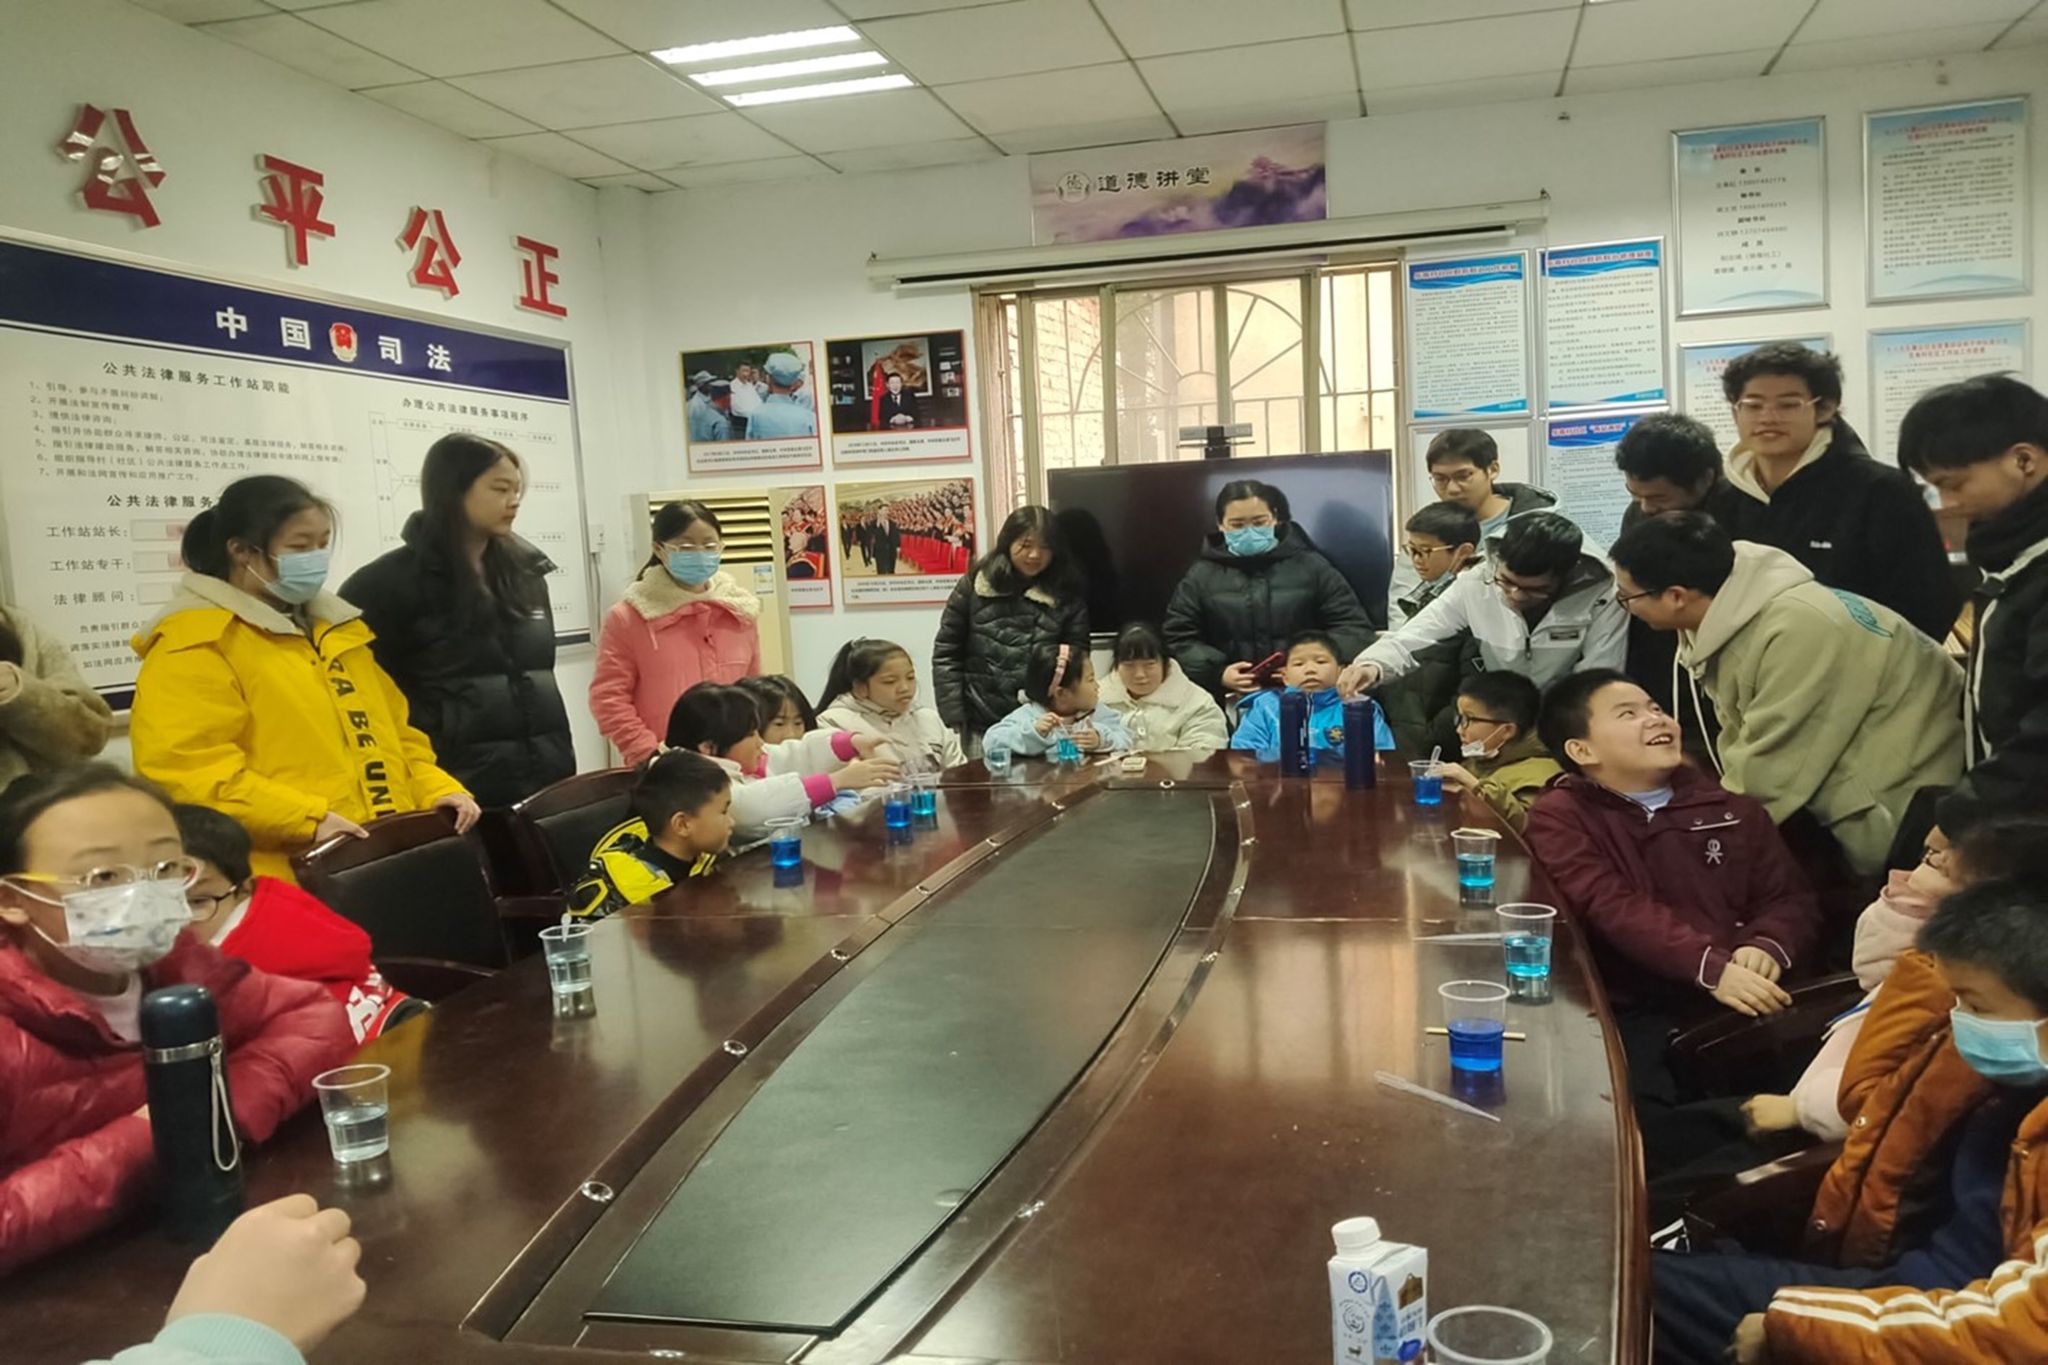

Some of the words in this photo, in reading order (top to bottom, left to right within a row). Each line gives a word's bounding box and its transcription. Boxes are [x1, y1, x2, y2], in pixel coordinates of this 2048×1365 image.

[1098, 166, 1211, 193] 道德讲堂
[55, 103, 568, 319] 公平公正
[216, 306, 453, 373] 中国司法
[102, 361, 291, 394] 公共法律服务工作站职能
[402, 397, 530, 422] 办理公共法律服务事项程序
[347, 710, 377, 748] BE
